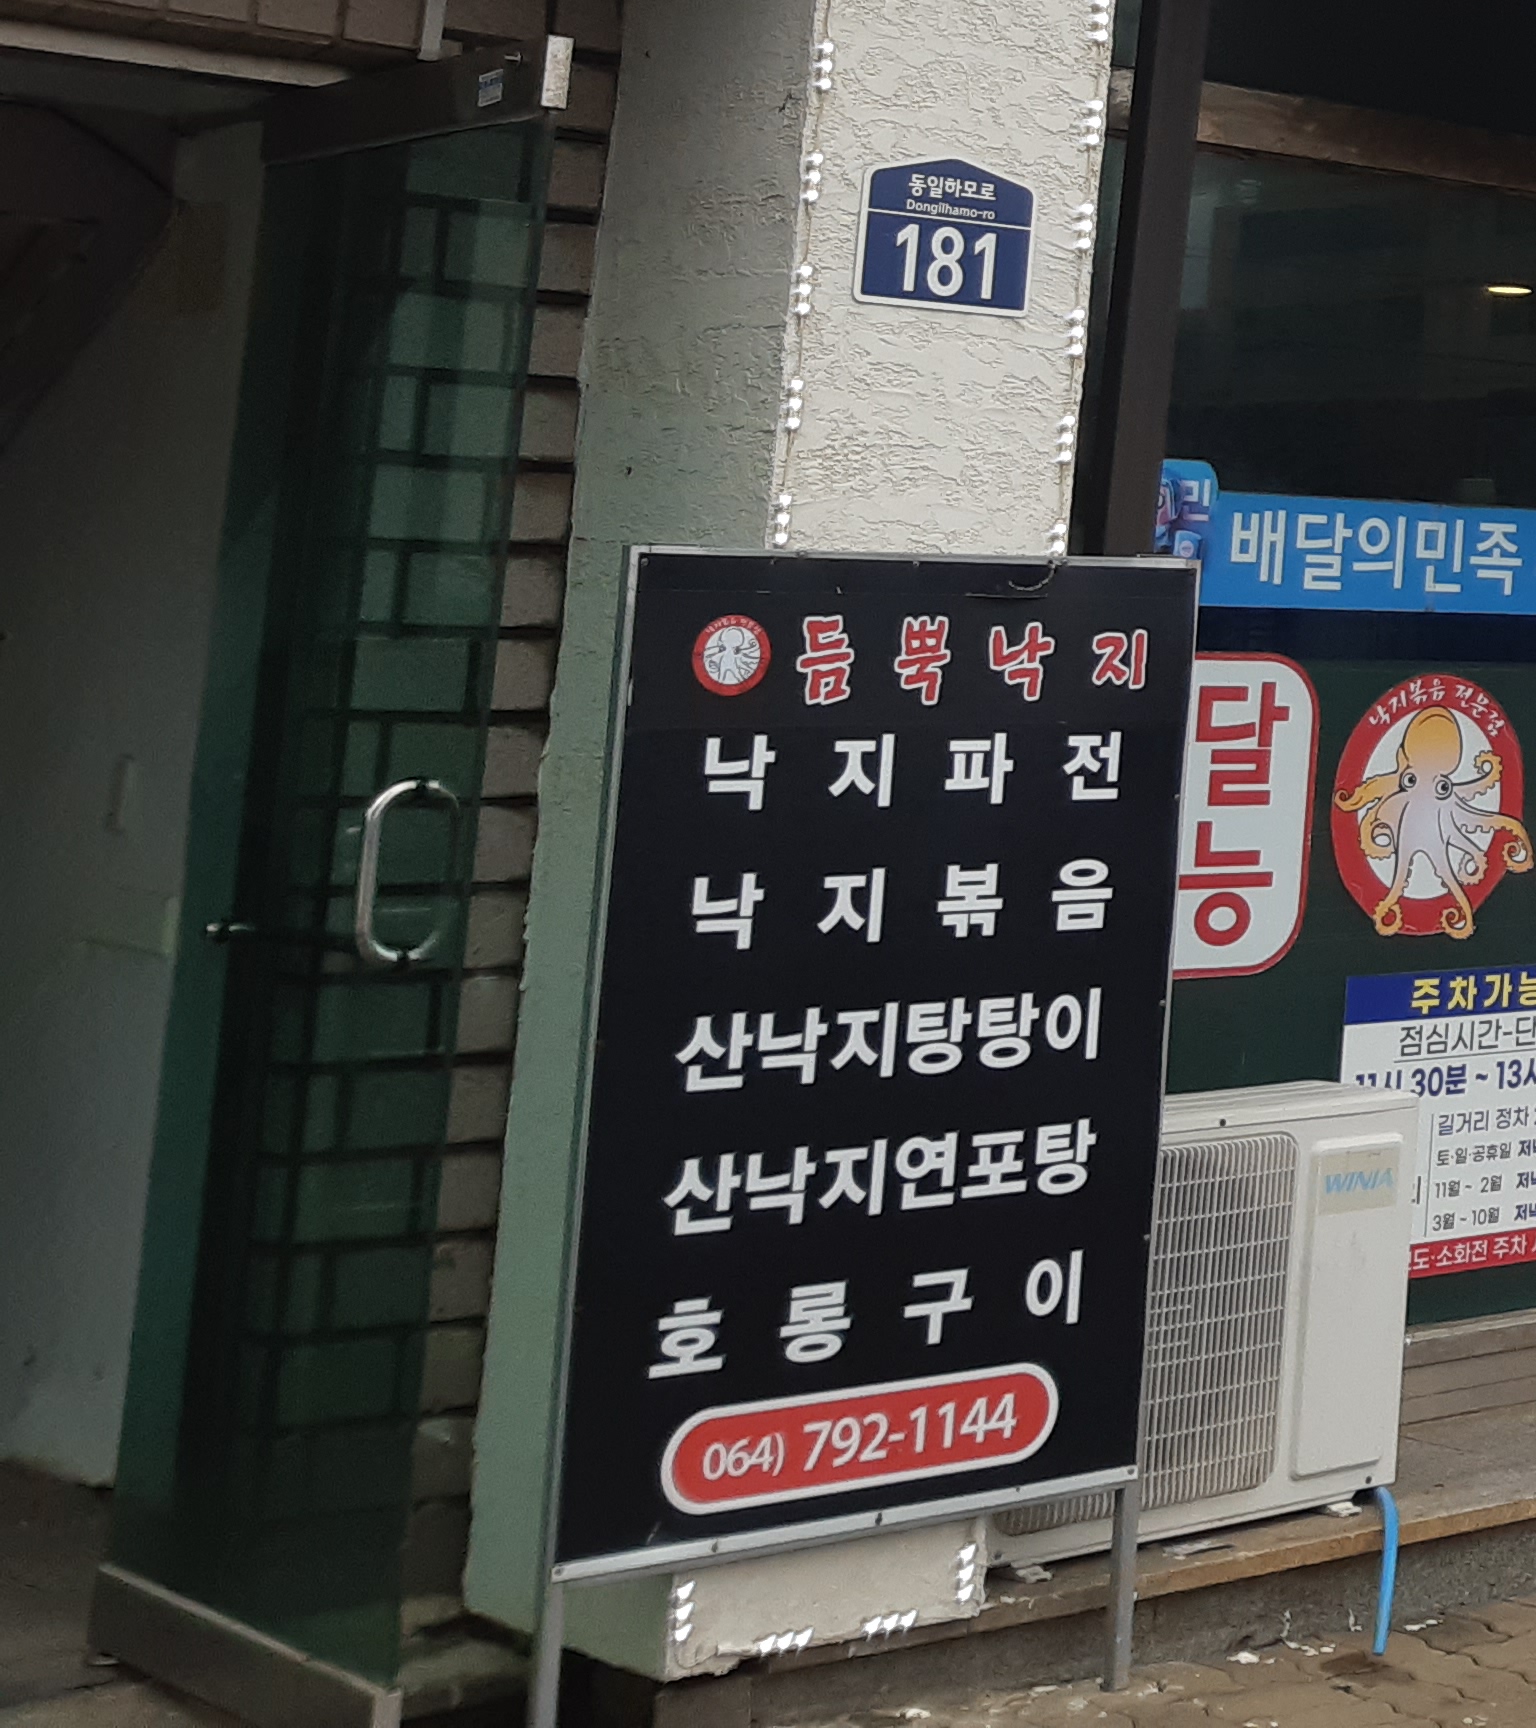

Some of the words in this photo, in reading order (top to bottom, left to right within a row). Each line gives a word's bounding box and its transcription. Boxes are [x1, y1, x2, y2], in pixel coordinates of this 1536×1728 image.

[908, 173, 997, 201] 동일하모로
[905, 198, 996, 220] Dongilhamo-ro
[896, 223, 998, 300] 181
[1230, 508, 1523, 597] 배달의민족
[1368, 678, 1446, 726] 낙지볶음
[1455, 684, 1505, 737] 전문점
[674, 987, 1103, 1094] 산낙지탕탕이
[1410, 1063, 1468, 1098] 30분
[1438, 1109, 1490, 1137] 길거리
[1495, 1106, 1530, 1130] 정차
[662, 1117, 1097, 1237] 산낙지연포탕
[1324, 1168, 1396, 1196] WINIA
[1434, 1179, 1461, 1199] 11월
[1480, 1174, 1503, 1195] 2월
[1432, 1212, 1456, 1232] 3월
[1472, 1206, 1501, 1226] 10월
[1408, 1239, 1488, 1271] 도·소화전
[1493, 1234, 1528, 1259] 주차
[702, 1437, 786, 1484] 064)
[803, 1390, 1018, 1474] 792-1144
